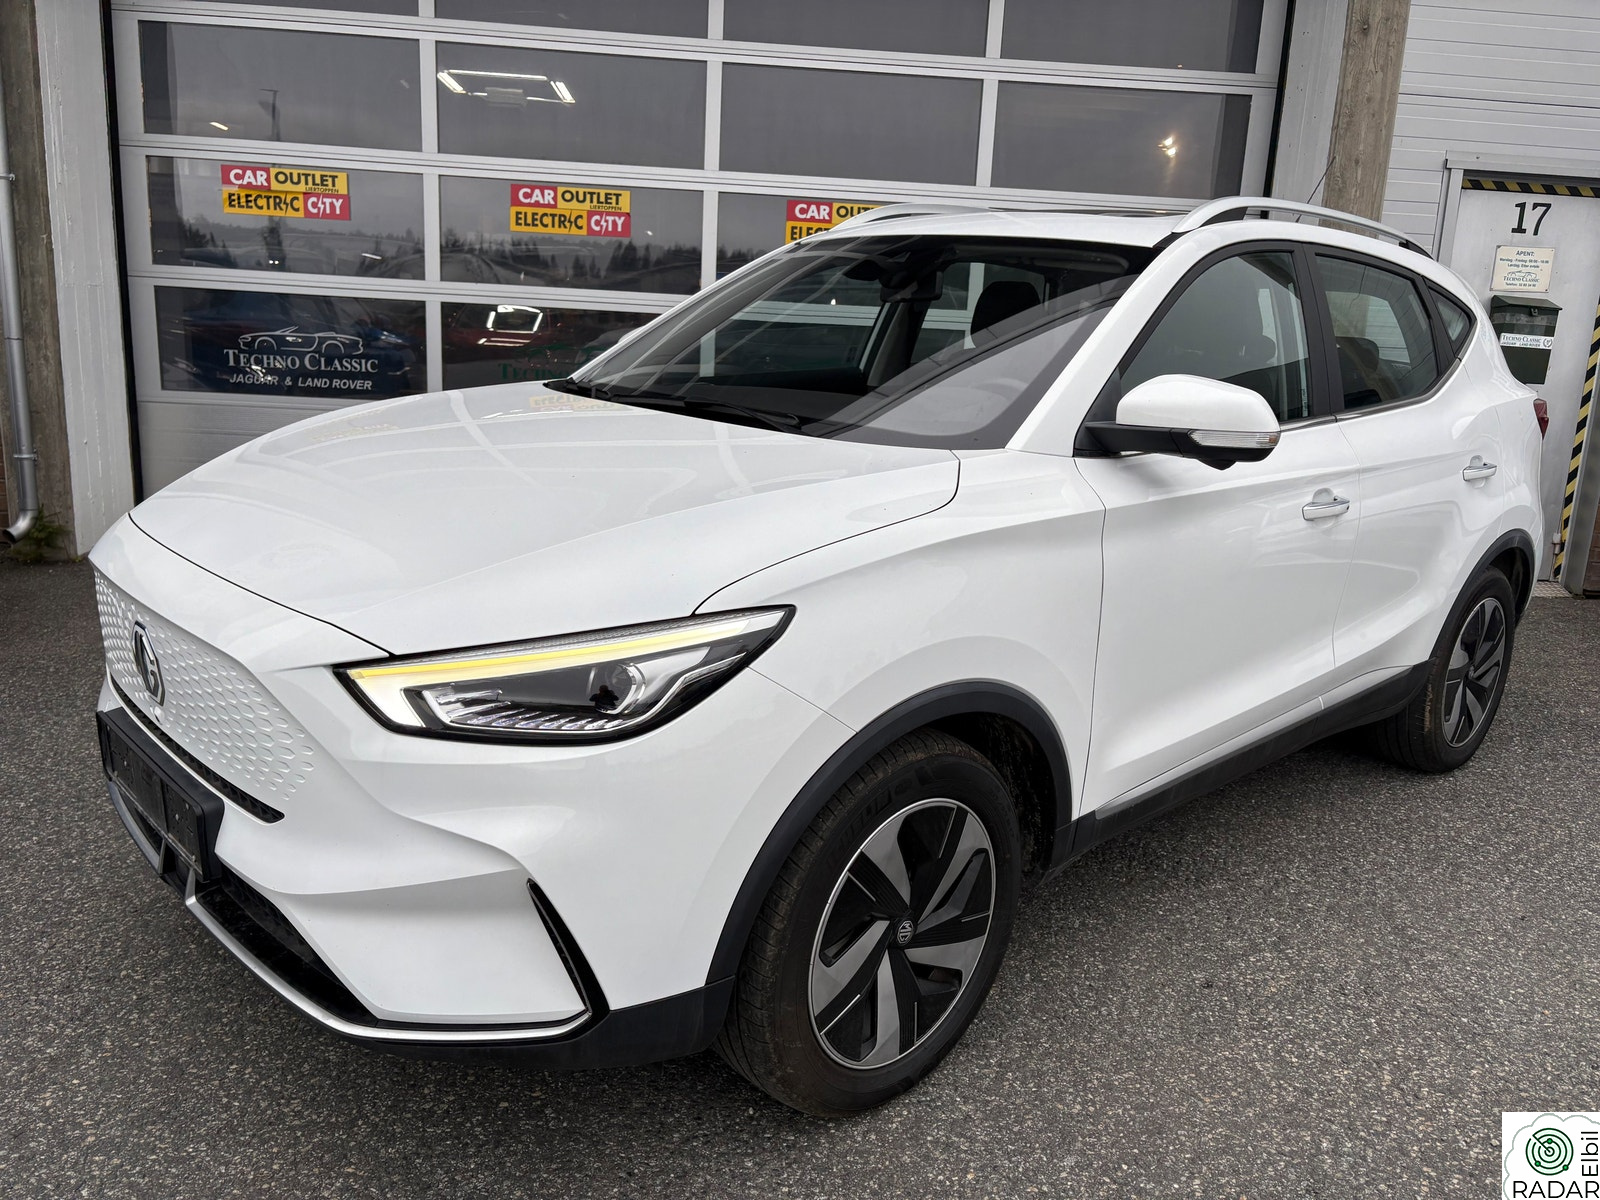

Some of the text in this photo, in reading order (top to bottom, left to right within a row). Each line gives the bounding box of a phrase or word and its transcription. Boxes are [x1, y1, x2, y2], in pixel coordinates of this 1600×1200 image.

[229, 169, 338, 187] CAR OUTLET
[518, 188, 622, 205] CAR OUTLET
[794, 204, 830, 220] CAR
[1511, 202, 1552, 236] 17
[223, 349, 379, 373] TECHNO CLASSIC
[229, 373, 373, 390] JAGUAR & LAND ROVER
